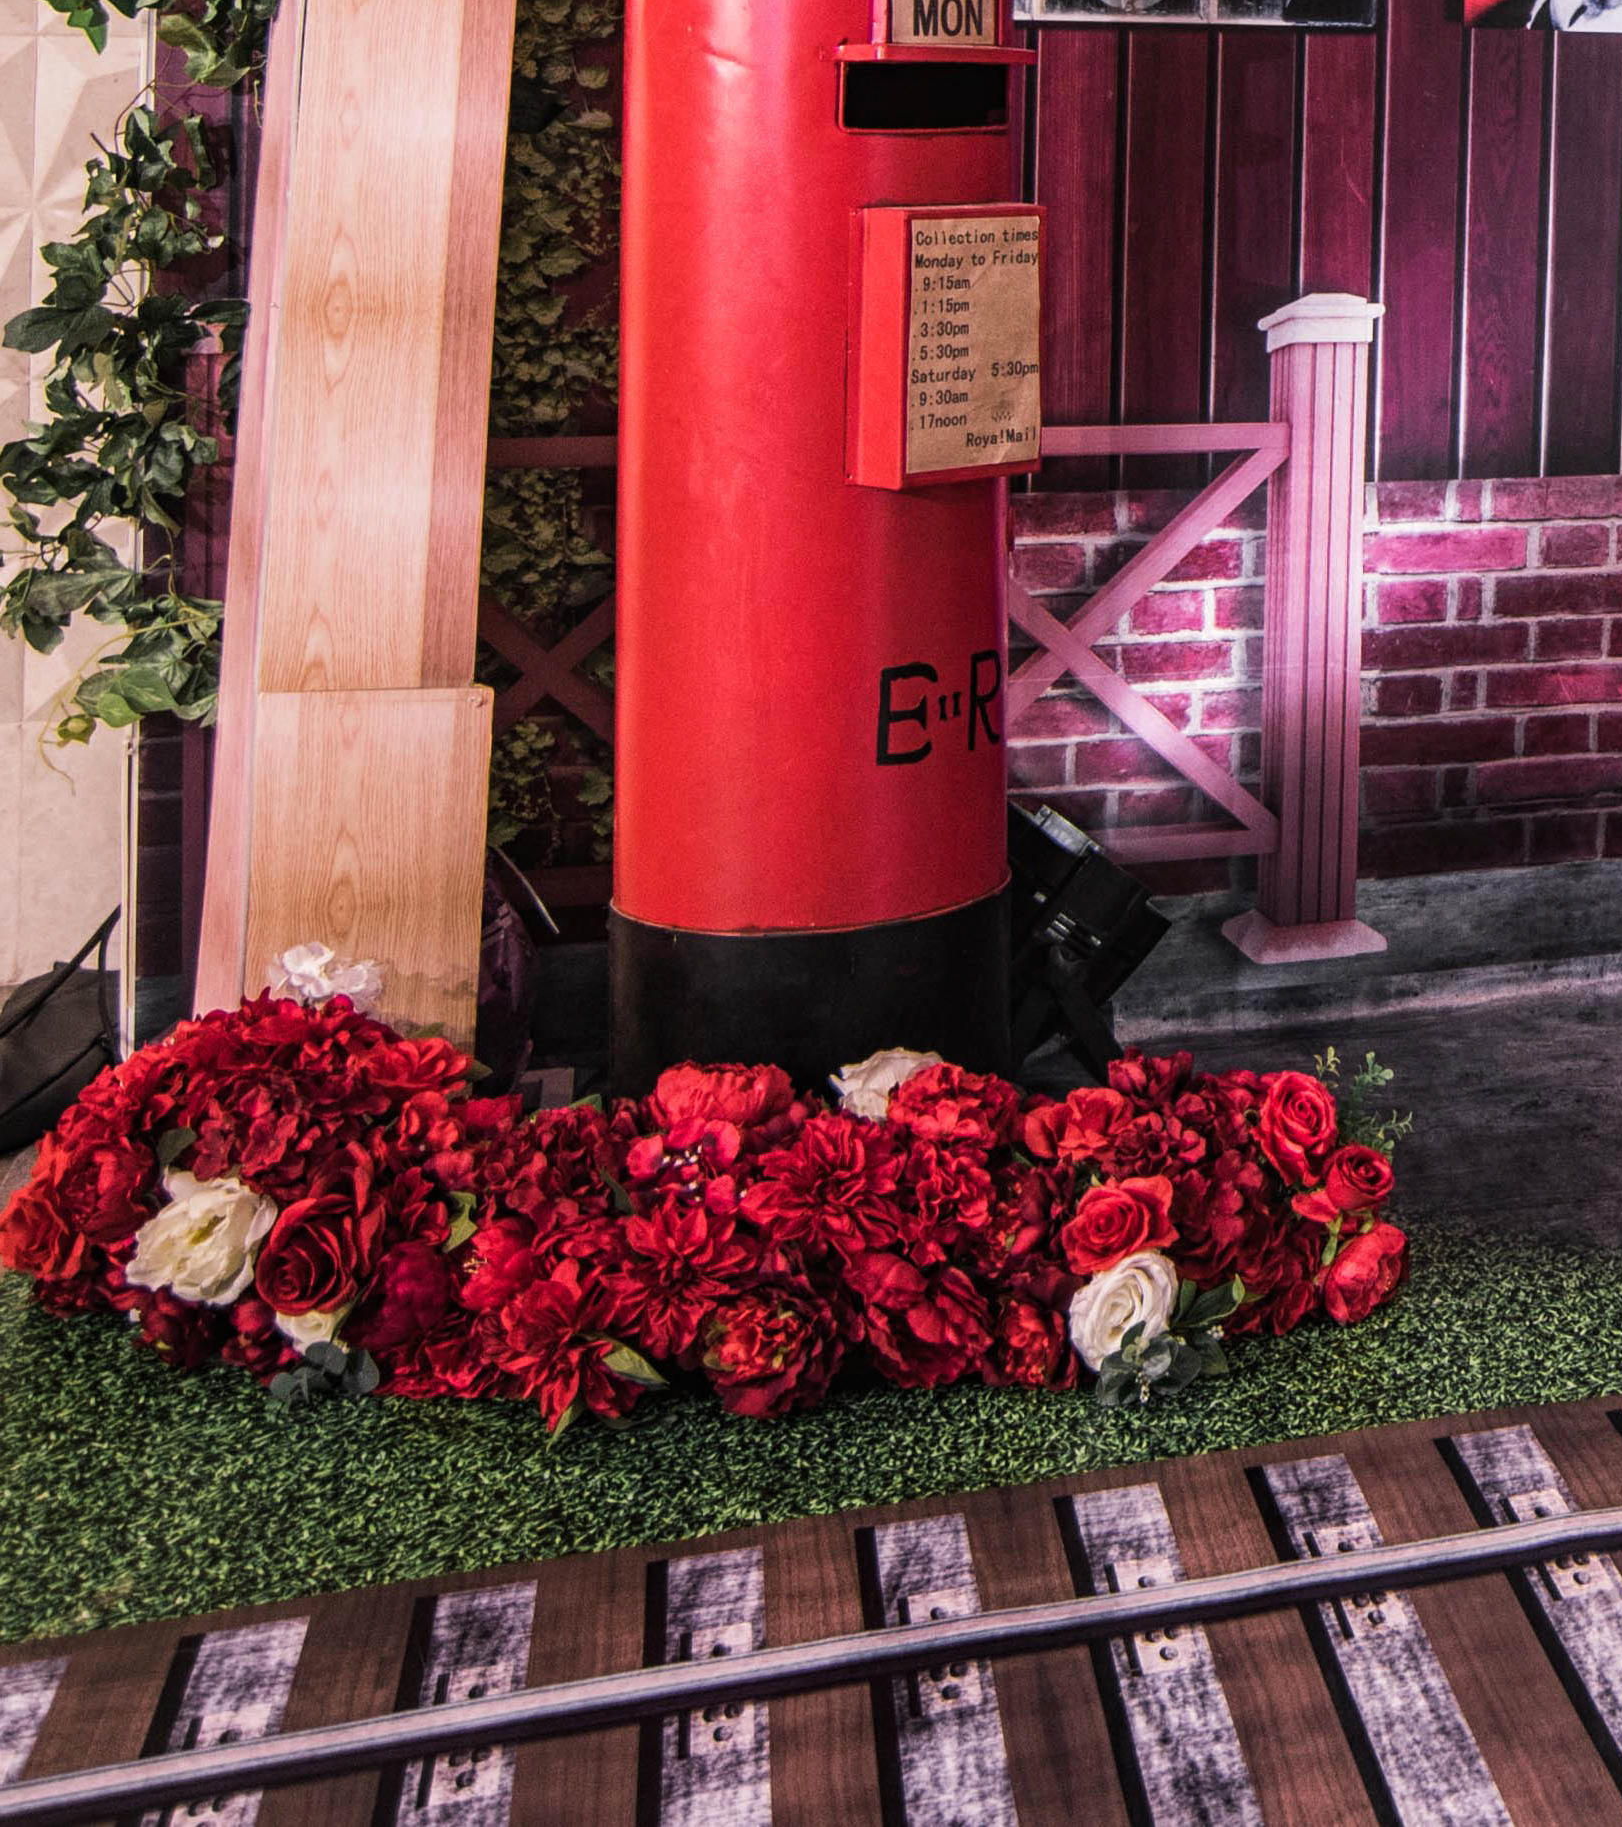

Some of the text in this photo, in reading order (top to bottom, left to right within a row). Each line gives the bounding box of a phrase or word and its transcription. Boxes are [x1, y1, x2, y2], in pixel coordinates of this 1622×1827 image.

[915, 227, 1039, 246] Collection times
[914, 249, 1039, 270] Monday to Friday
[910, 360, 1039, 384] Saturday 5:30pm
